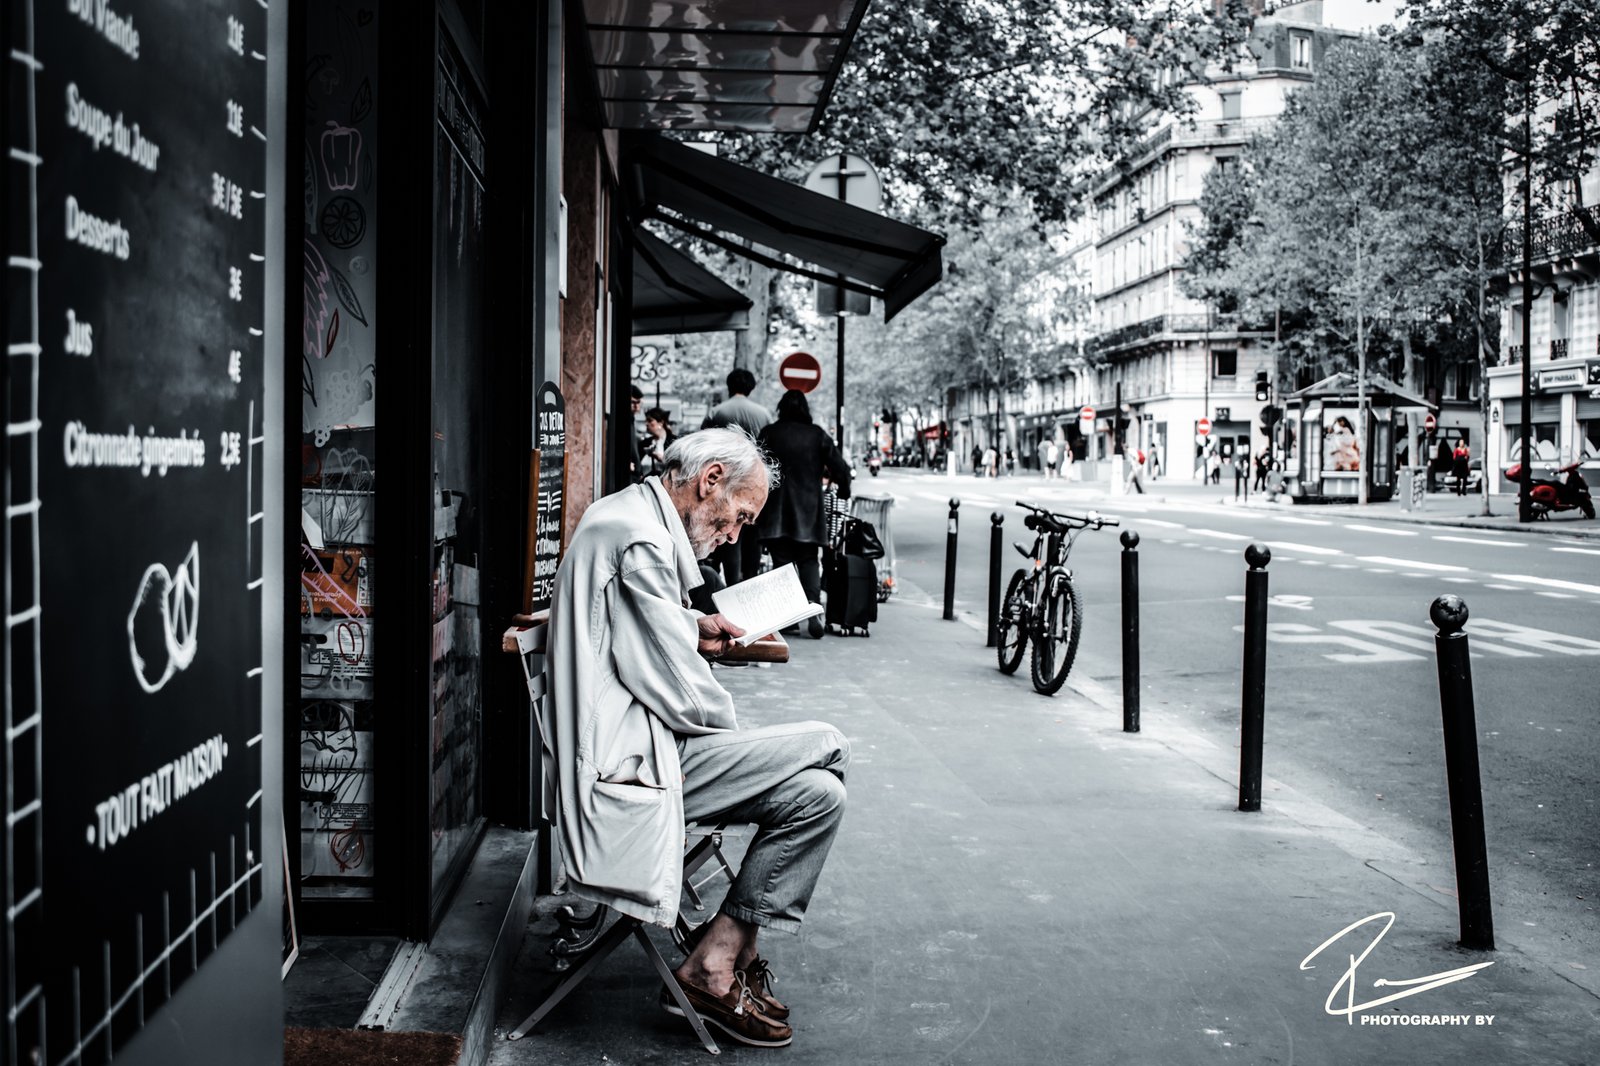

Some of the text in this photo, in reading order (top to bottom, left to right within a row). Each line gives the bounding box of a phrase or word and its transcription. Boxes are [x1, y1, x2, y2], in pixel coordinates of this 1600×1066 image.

[67, 82, 159, 171] Soupe du Jour
[65, 195, 130, 261] Desserts
[64, 308, 93, 357] Jus
[63, 421, 142, 467] Citronnade
[95, 733, 223, 851] TOUT FAIT MAISON
